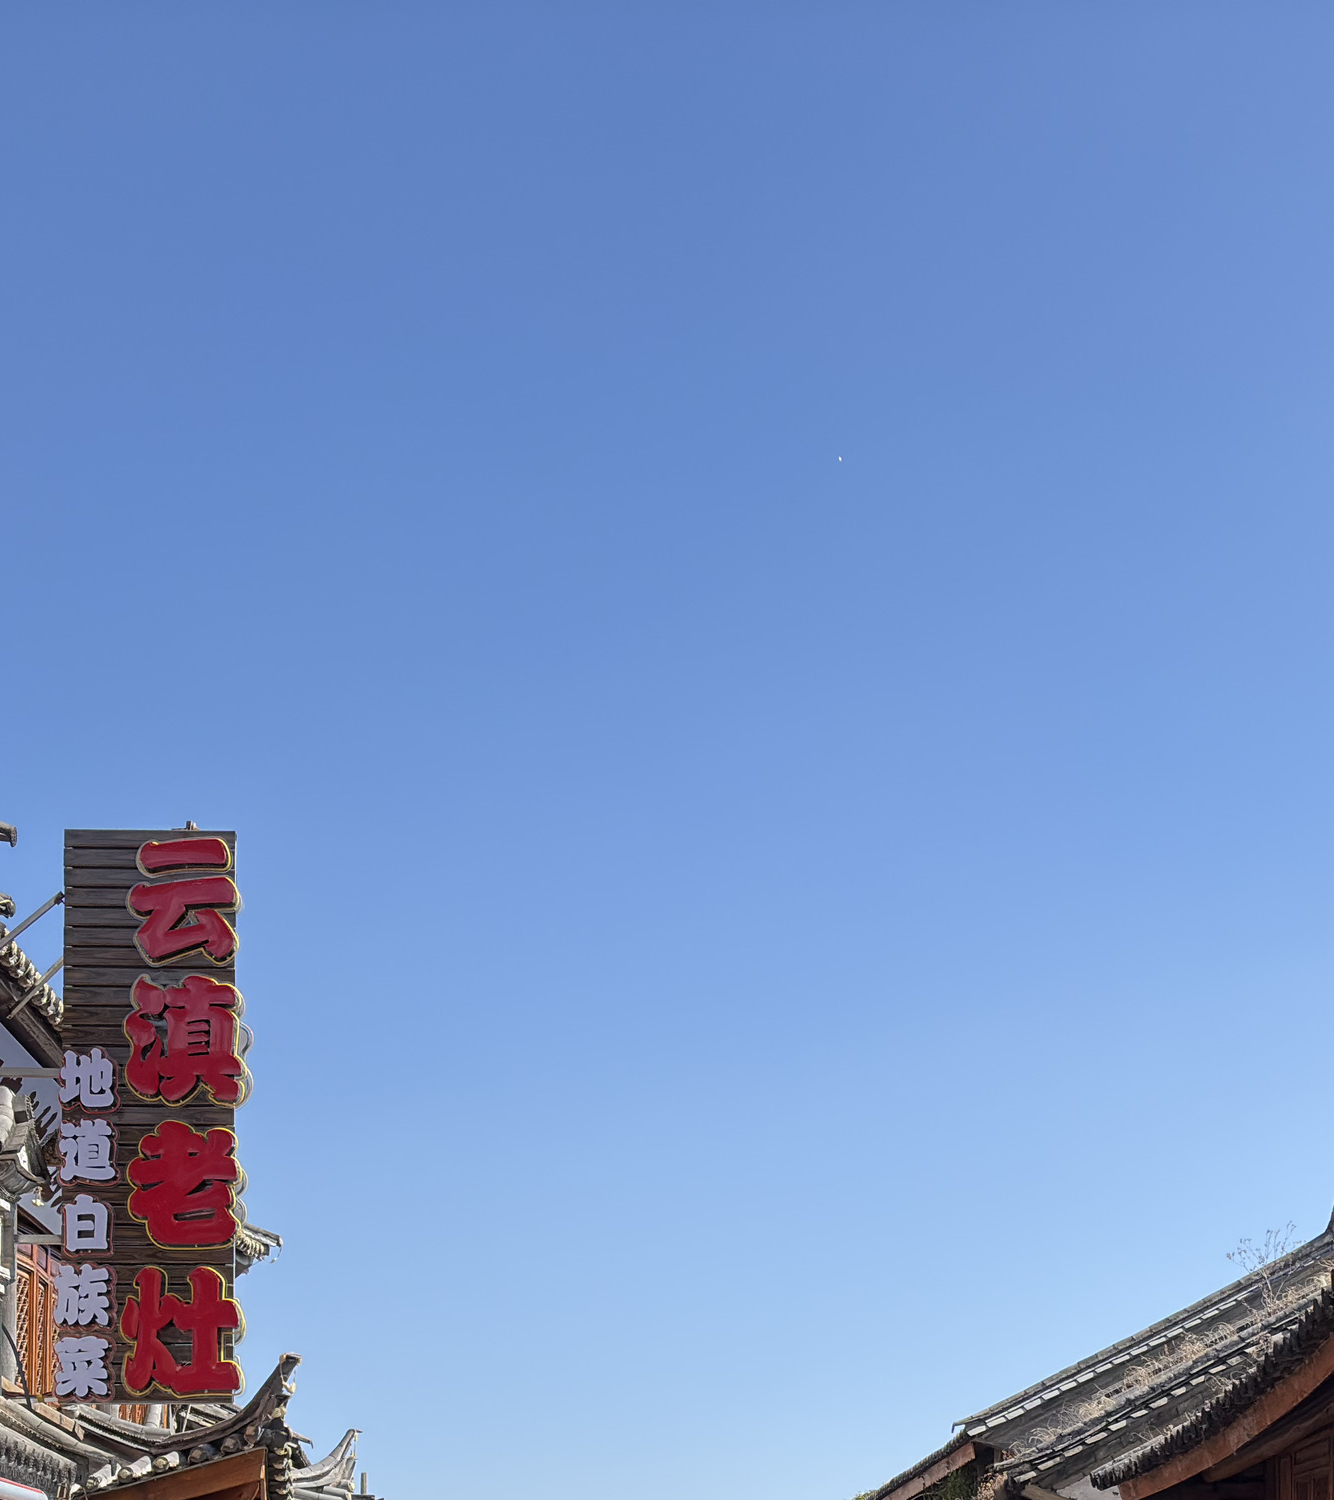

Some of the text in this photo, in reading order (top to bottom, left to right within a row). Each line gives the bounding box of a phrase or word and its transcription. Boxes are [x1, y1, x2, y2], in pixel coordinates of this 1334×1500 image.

[55, 1049, 115, 1398] 地道白族菜
[124, 836, 245, 1397] 云滇老灶
